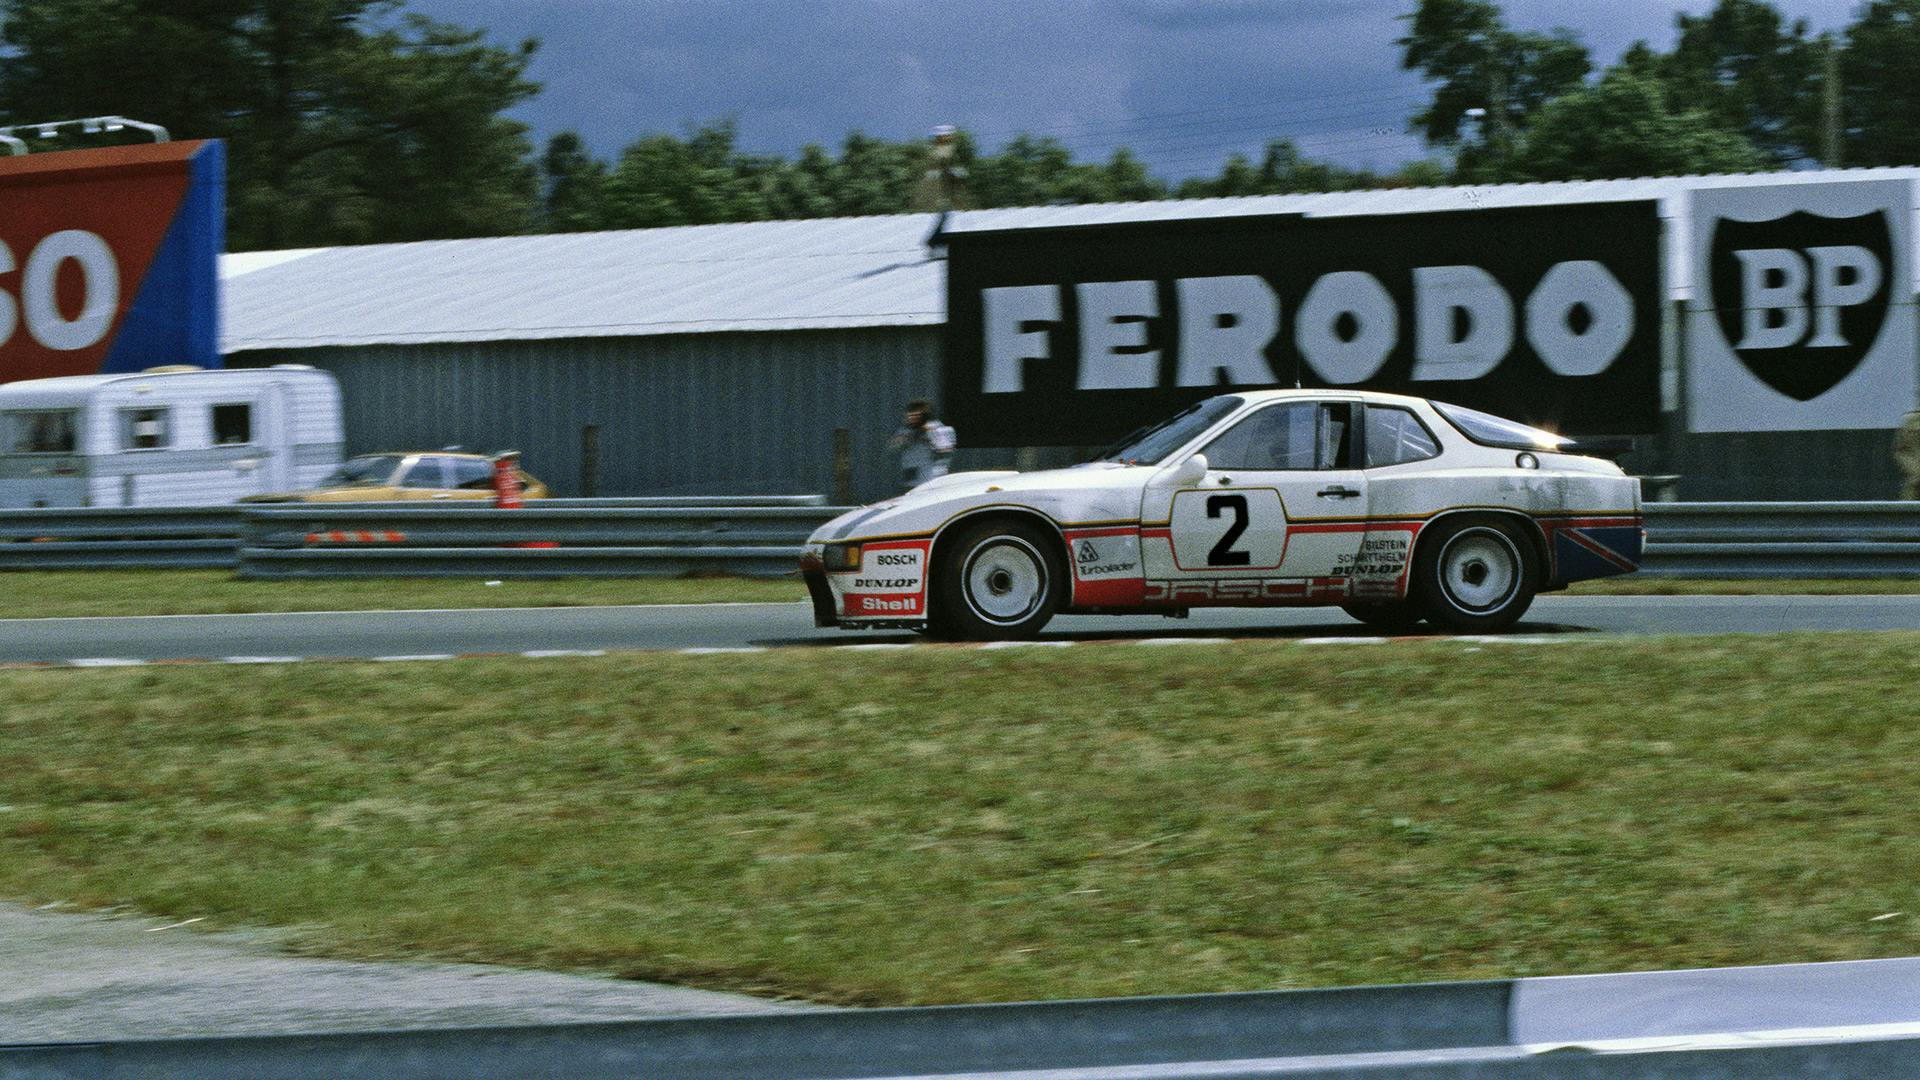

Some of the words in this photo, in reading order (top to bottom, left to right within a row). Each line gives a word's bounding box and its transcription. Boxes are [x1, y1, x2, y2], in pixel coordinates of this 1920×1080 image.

[0, 229, 120, 350] O
[1731, 245, 1883, 350] BP
[981, 260, 1635, 393] FERODO
[1207, 495, 1250, 566] 2
[1365, 540, 1406, 550] BILSTEIN
[877, 554, 917, 566] BOSCH
[1331, 564, 1403, 576] DUNLOP
[855, 578, 919, 588] DUNLOP
[863, 597, 917, 610] Shell
